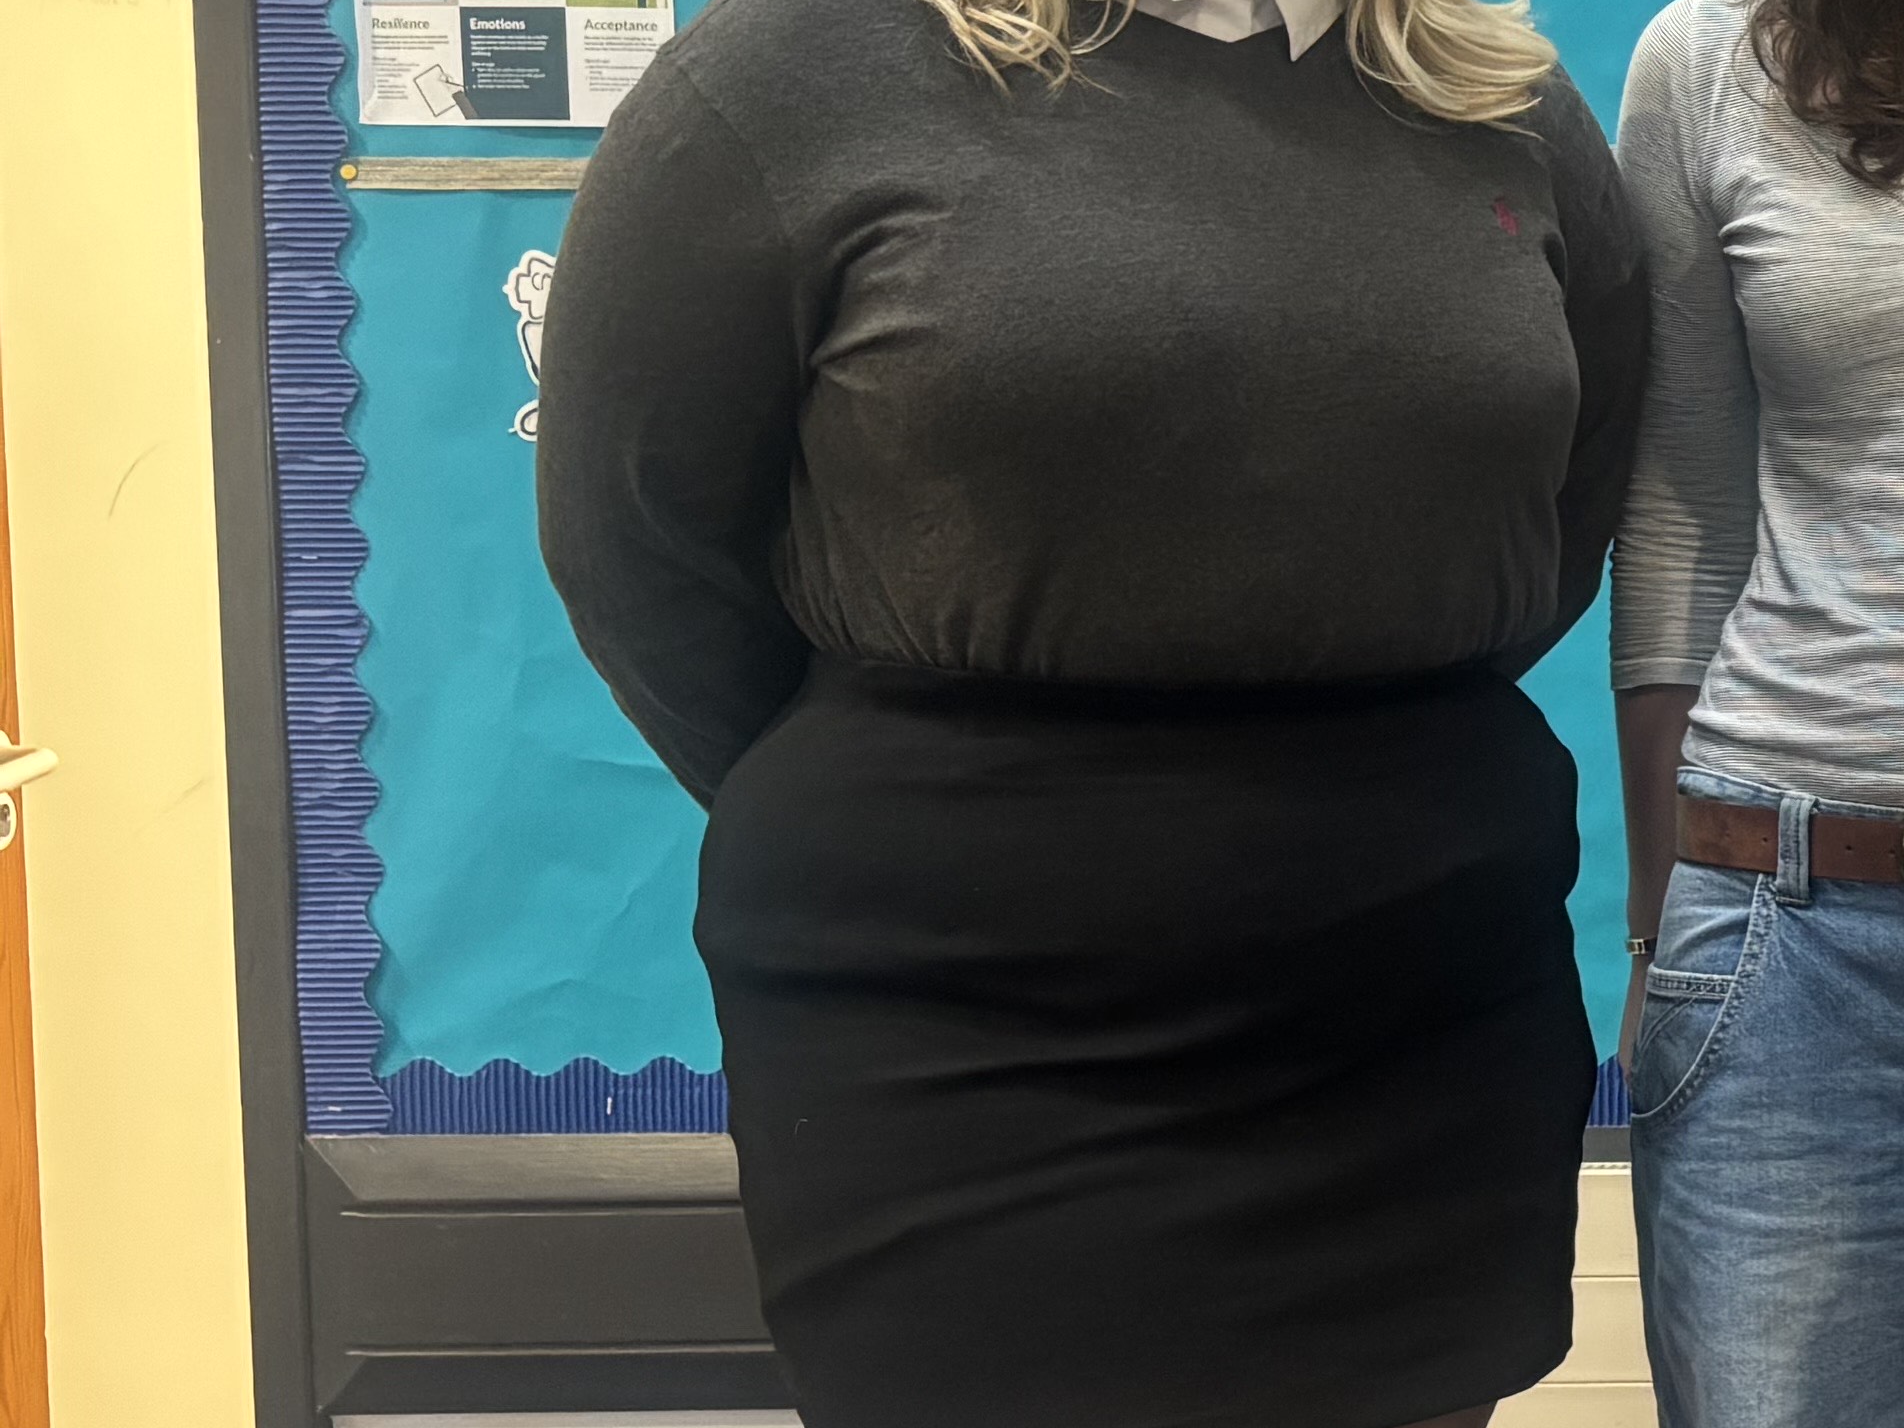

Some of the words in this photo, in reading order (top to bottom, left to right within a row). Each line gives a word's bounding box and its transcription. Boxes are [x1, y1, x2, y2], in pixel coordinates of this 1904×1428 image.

[372, 18, 430, 30] Resilience
[470, 17, 526, 30] Emotions
[584, 19, 658, 32] Acceptance
